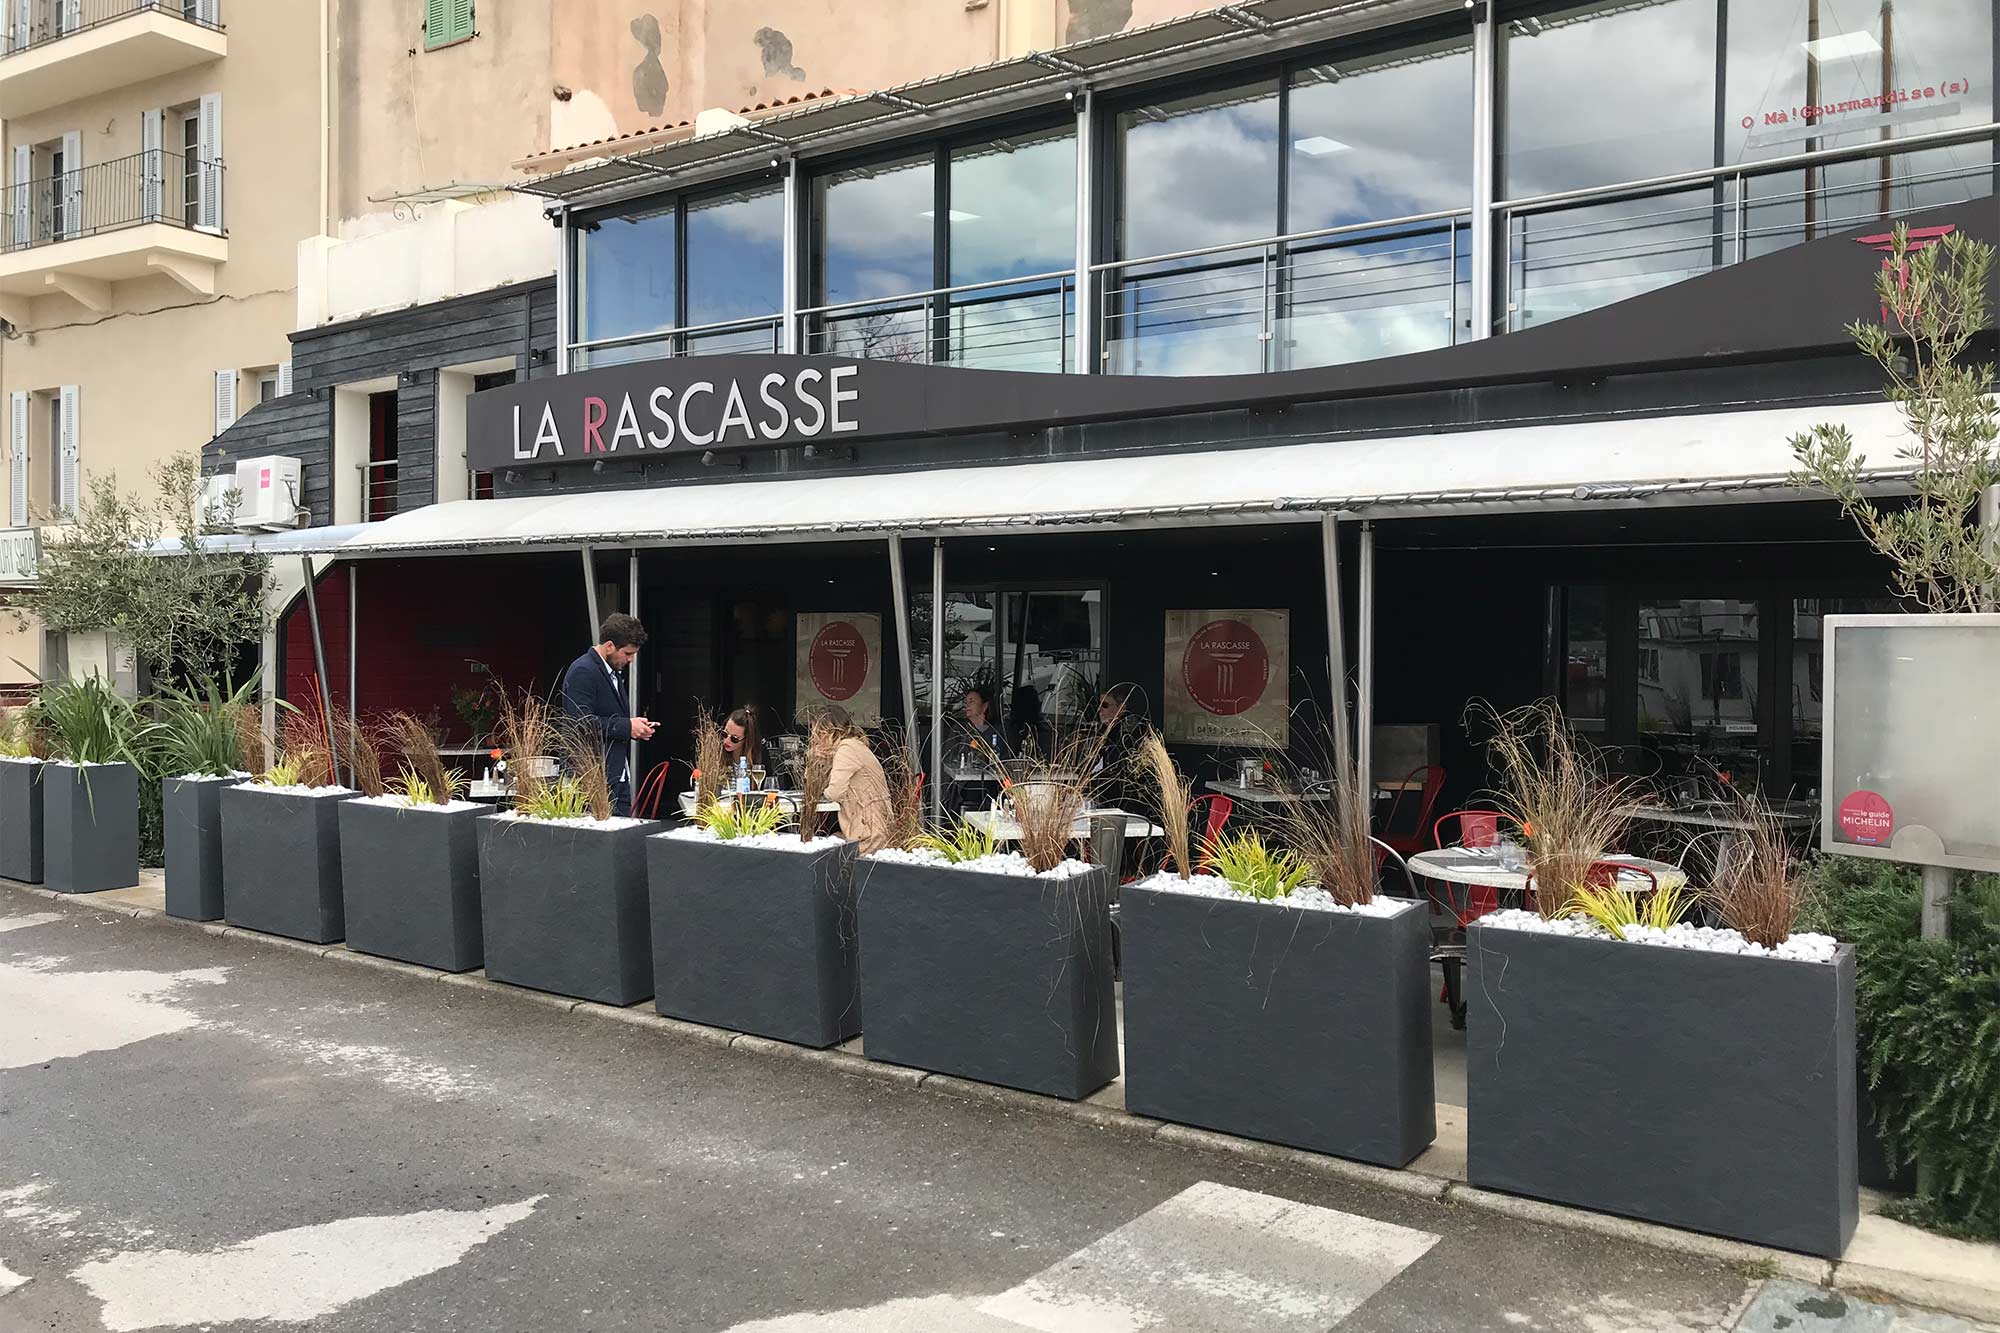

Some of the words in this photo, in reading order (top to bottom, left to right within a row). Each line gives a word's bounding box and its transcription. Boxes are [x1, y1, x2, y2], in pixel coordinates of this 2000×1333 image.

[513, 401, 565, 460] LA
[584, 365, 859, 454] RASCASSE
[1201, 642, 1210, 650] LA
[1212, 641, 1250, 650] RASCASSE
[1843, 816, 1890, 827] MICHELIN
